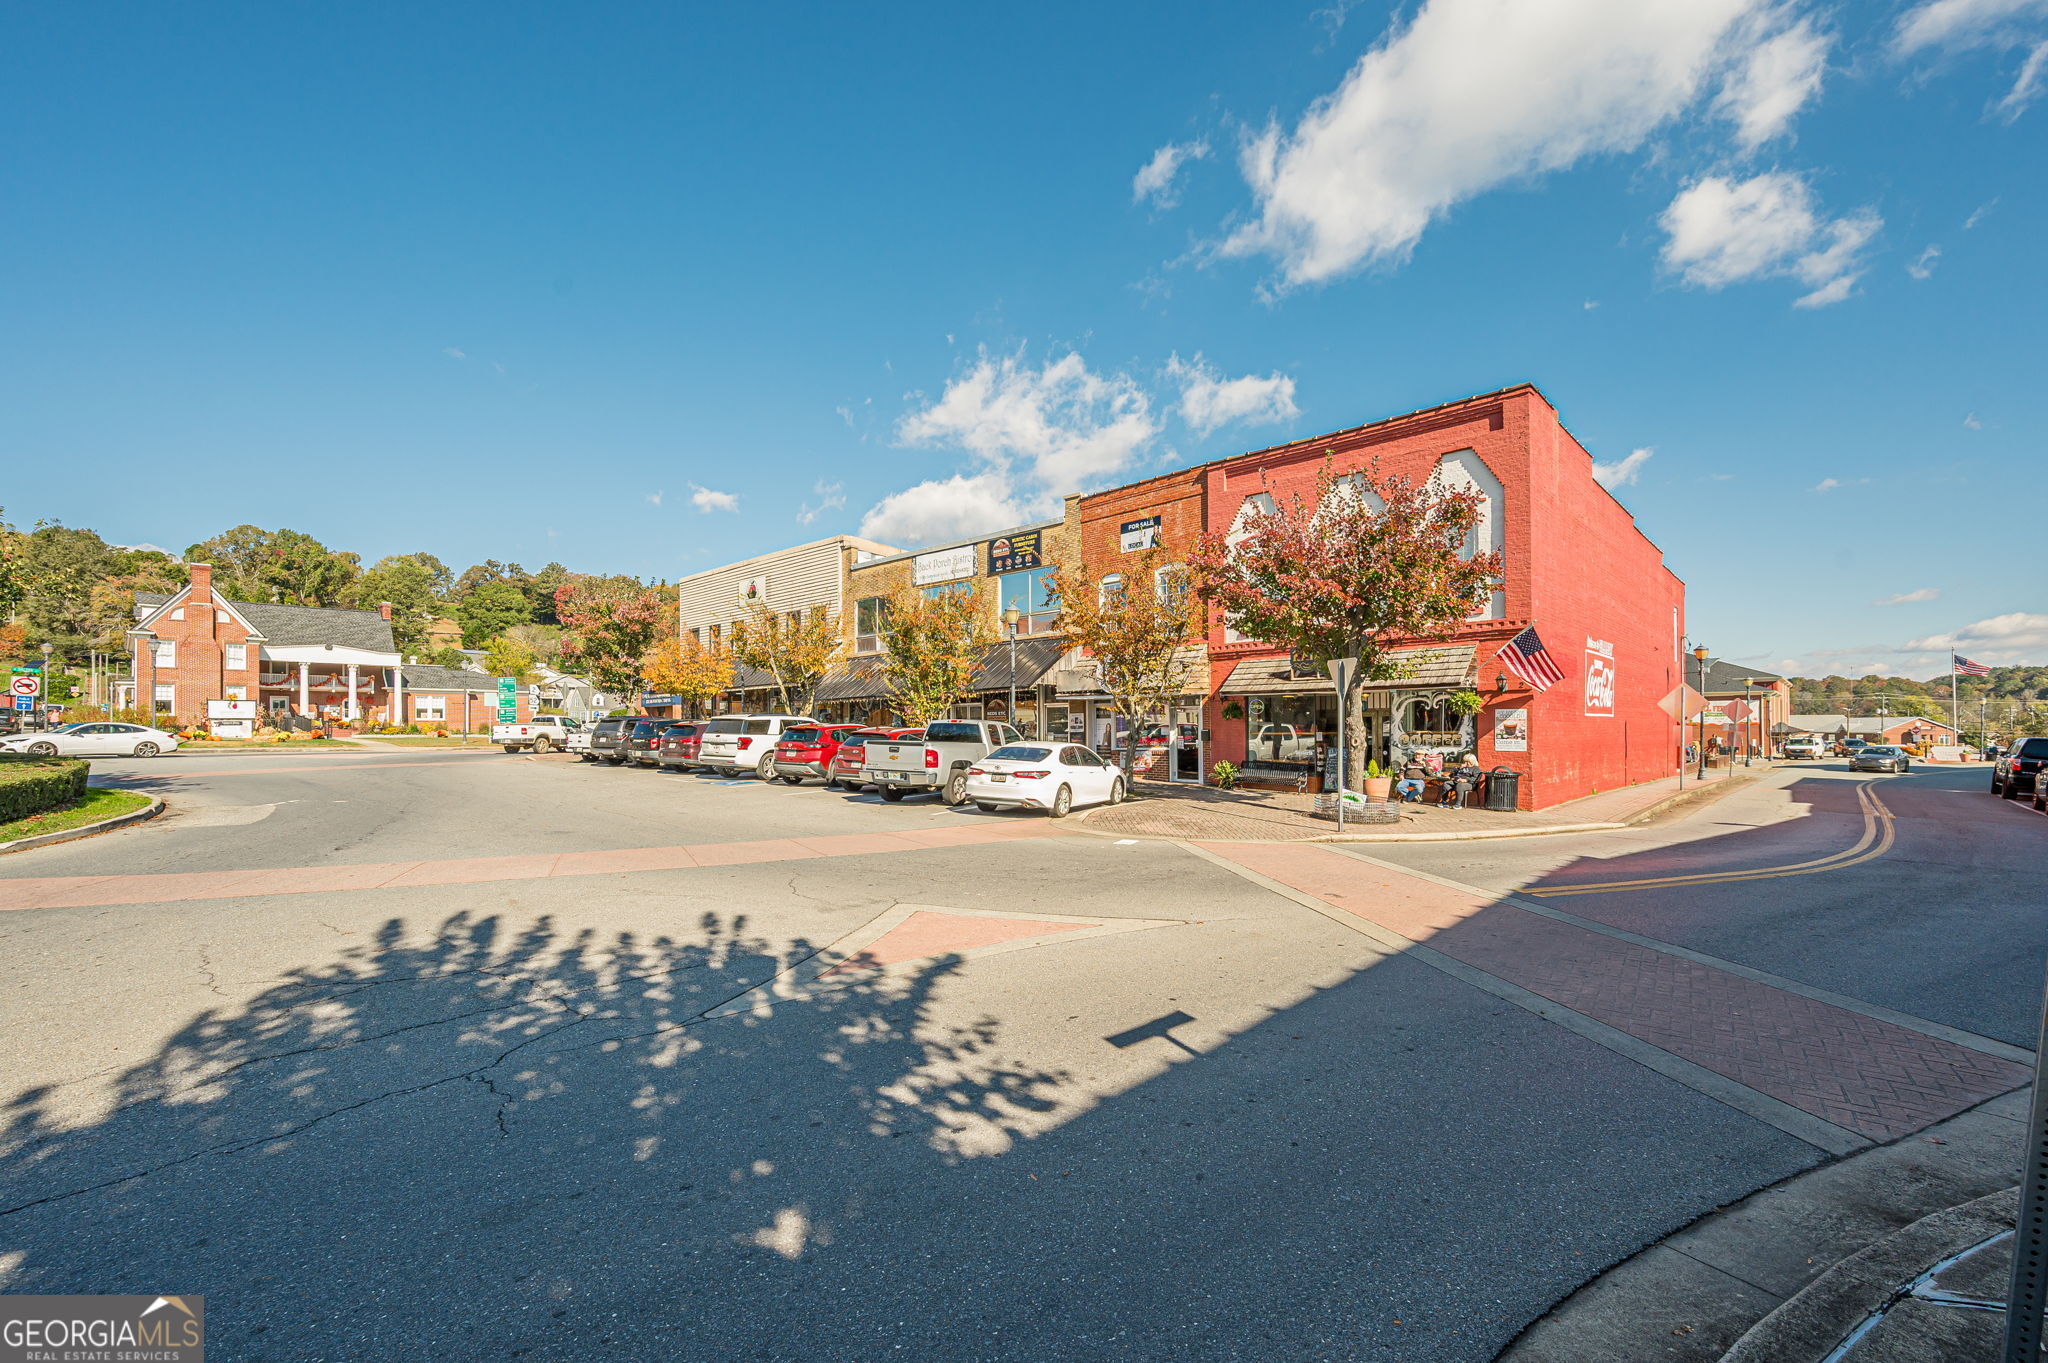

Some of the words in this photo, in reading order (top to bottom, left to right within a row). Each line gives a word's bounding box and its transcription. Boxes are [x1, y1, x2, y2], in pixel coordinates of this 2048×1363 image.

[1128, 523, 1140, 531] FOR
[1139, 519, 1154, 527] SALE
[918, 560, 931, 573] Back
[933, 557, 951, 571] Porch
[953, 554, 972, 567] Bistro
[1398, 733, 1463, 747] COFFEE
